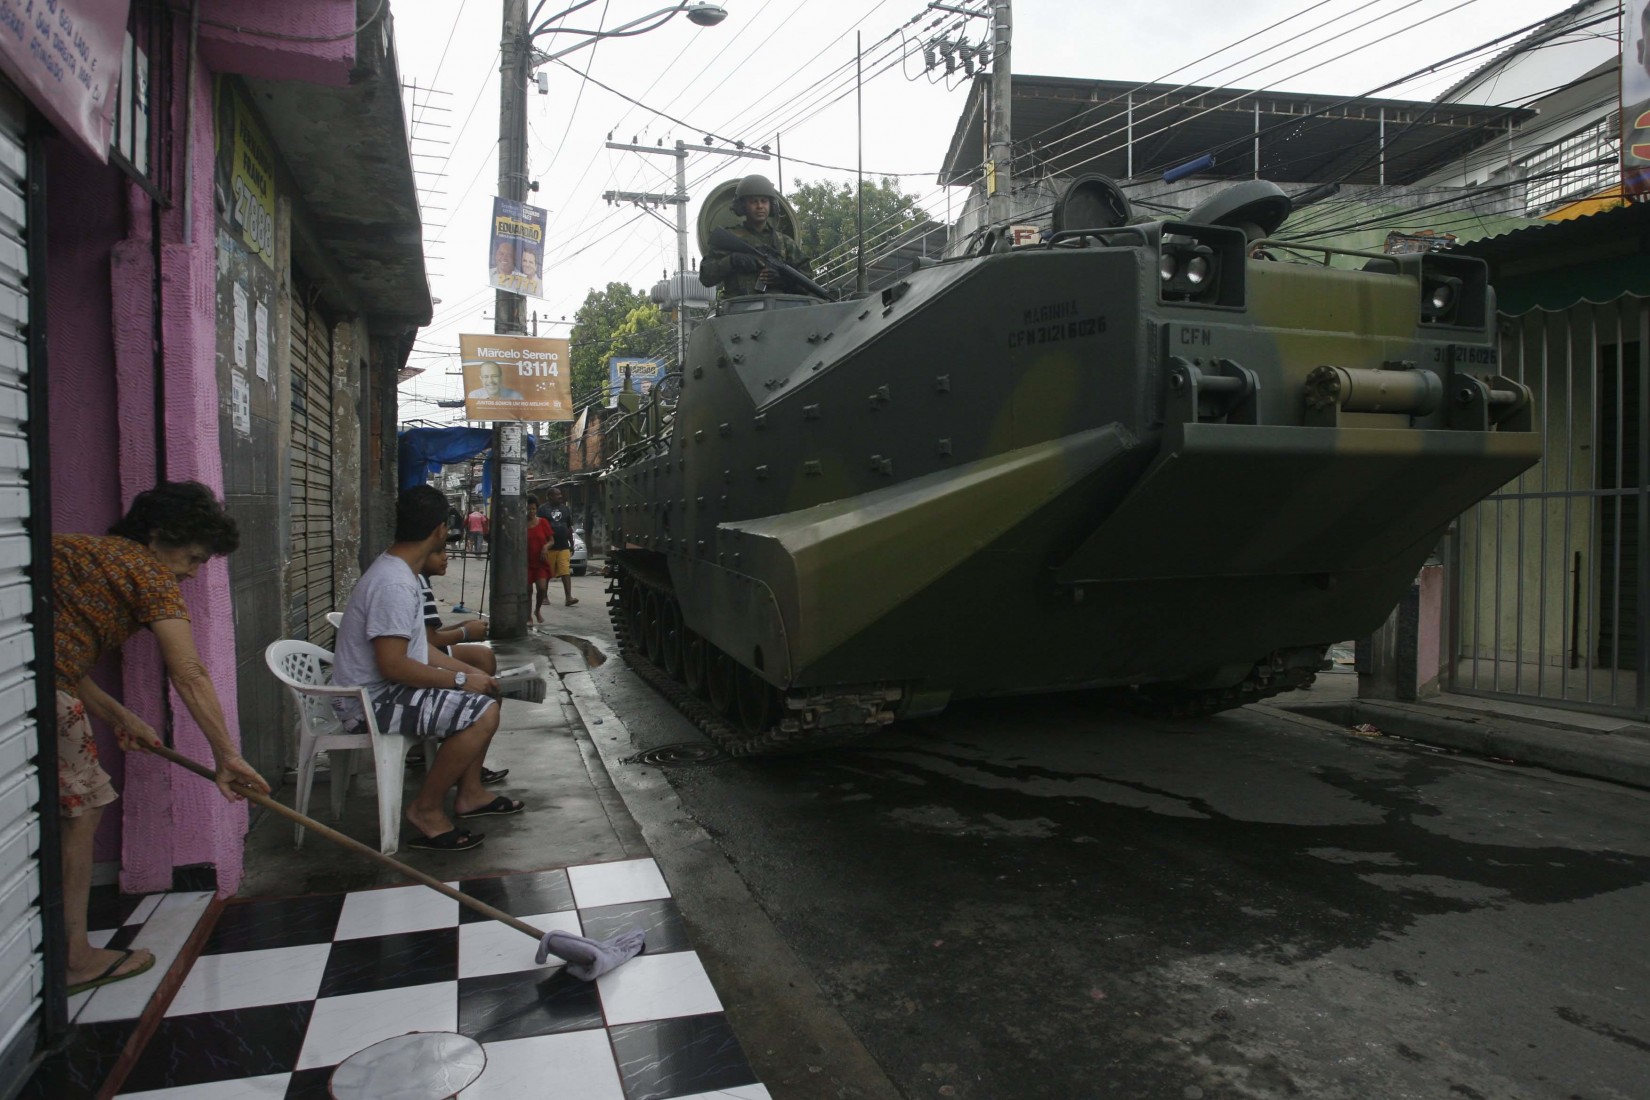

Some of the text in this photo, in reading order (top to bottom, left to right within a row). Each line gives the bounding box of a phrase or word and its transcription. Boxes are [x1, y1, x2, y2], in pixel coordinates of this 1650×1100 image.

[234, 175, 273, 258] 27888
[498, 221, 539, 240] EDUARDÃO
[1181, 327, 1211, 346] CFN
[477, 347, 558, 360] Marcelo Sereno
[517, 361, 559, 377] 13114
